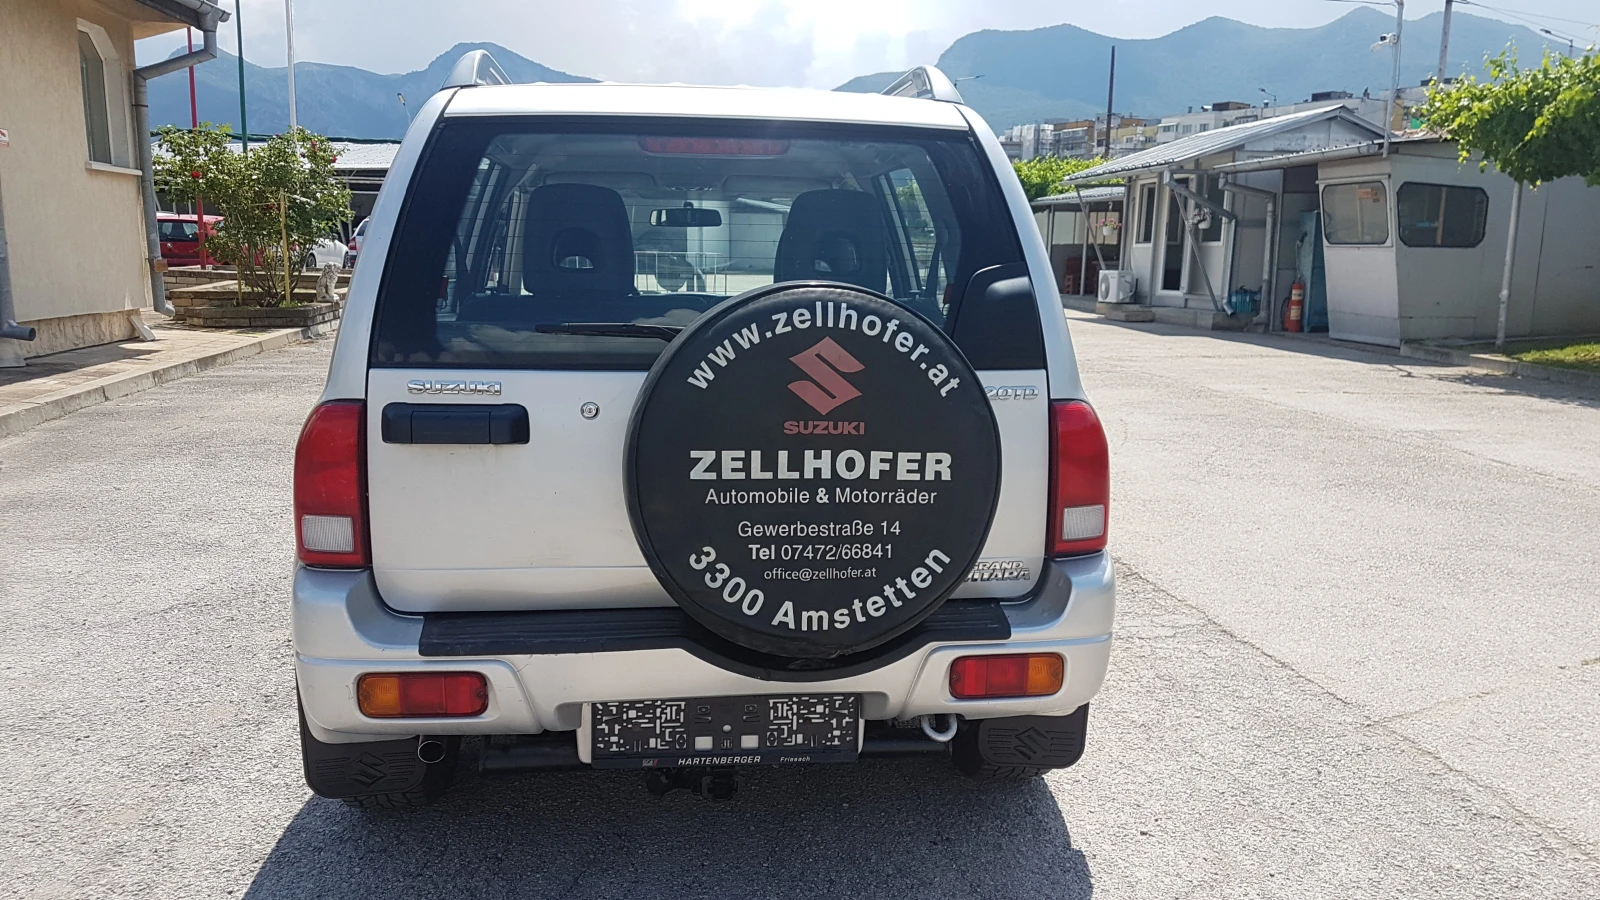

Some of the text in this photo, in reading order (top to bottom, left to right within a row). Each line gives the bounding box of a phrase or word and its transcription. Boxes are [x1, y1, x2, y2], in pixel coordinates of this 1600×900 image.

[687, 301, 961, 398] www.zellhofer.at
[407, 379, 502, 396] SUZUKI
[783, 420, 865, 436] SUZUKI
[689, 449, 952, 481] ZELLHOFER
[704, 487, 938, 506] Automobile & Motorräder
[737, 520, 901, 538] Gewerbestraße 14
[748, 543, 893, 561] Tel 07472/66841
[763, 567, 877, 583] office@zellhofer.at
[688, 546, 951, 632] 3300 Amstetten
[677, 755, 761, 767] HARTENBERGER
